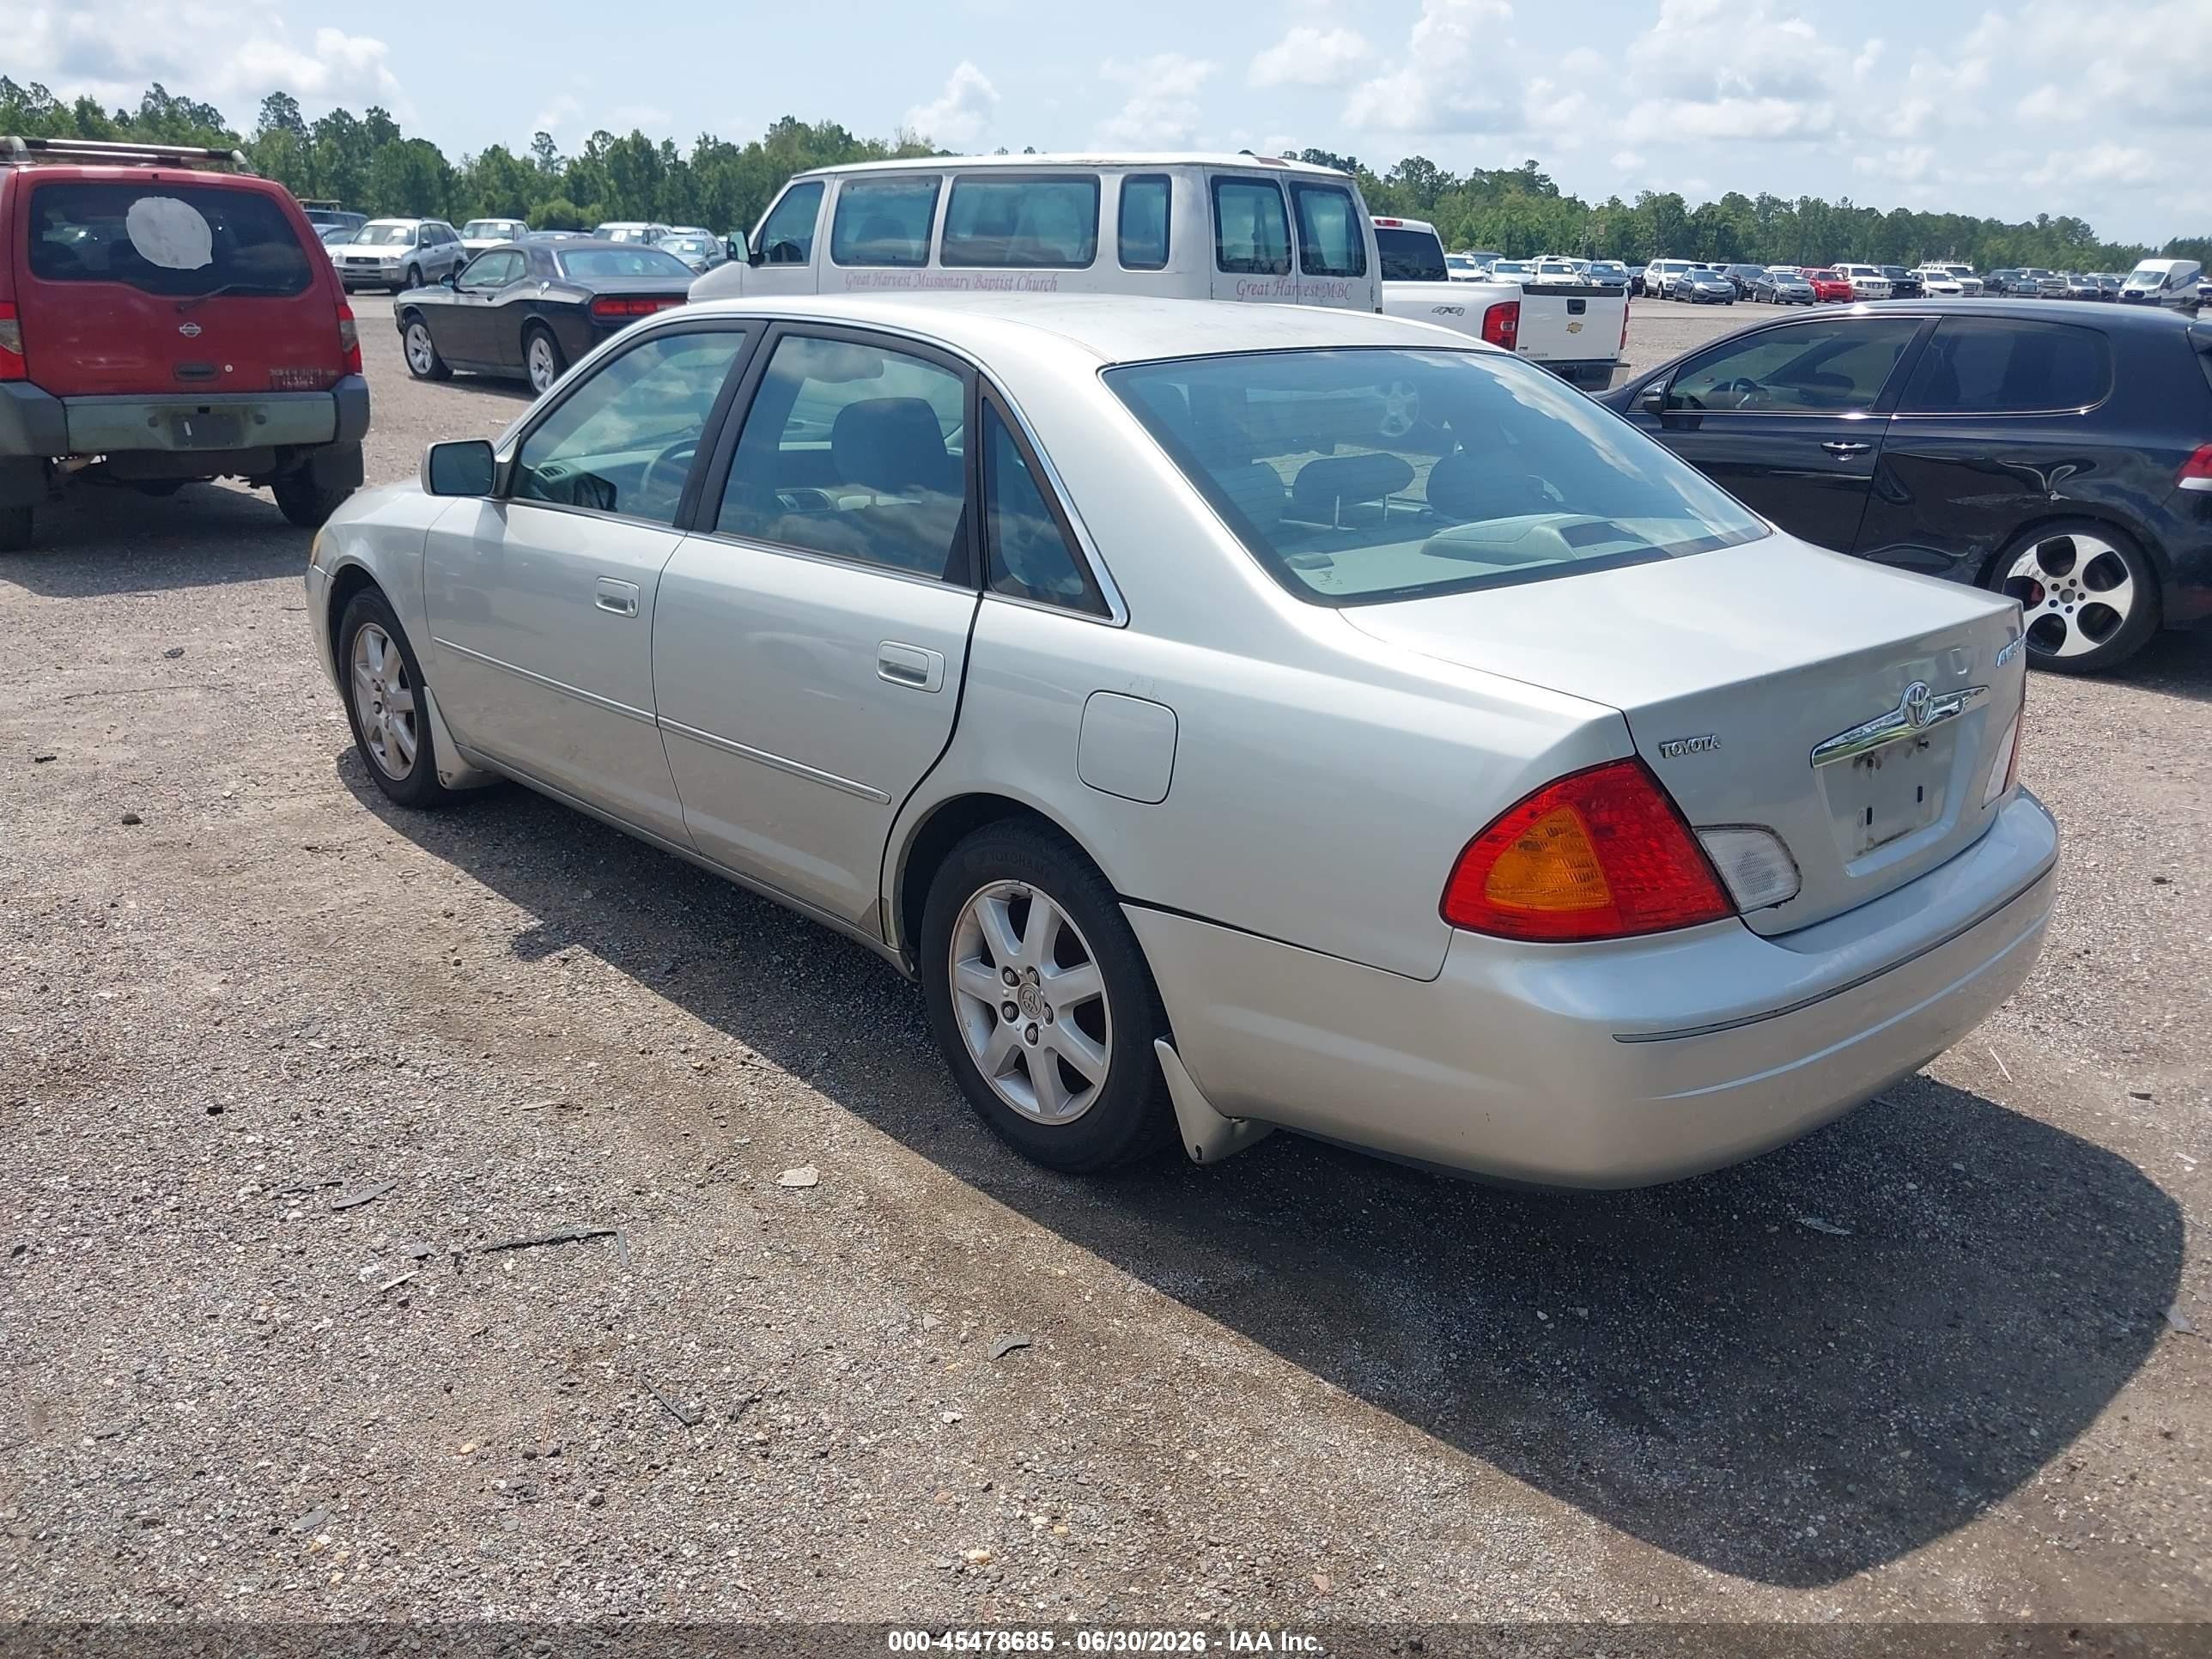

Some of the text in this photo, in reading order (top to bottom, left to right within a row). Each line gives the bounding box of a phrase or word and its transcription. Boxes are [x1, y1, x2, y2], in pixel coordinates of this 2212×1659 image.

[844, 271, 1059, 291] Great Harvest Missionary Baptist Church
[1236, 278, 1353, 301] Great Harvest MBC
[1658, 734, 1722, 758] TOYOTA
